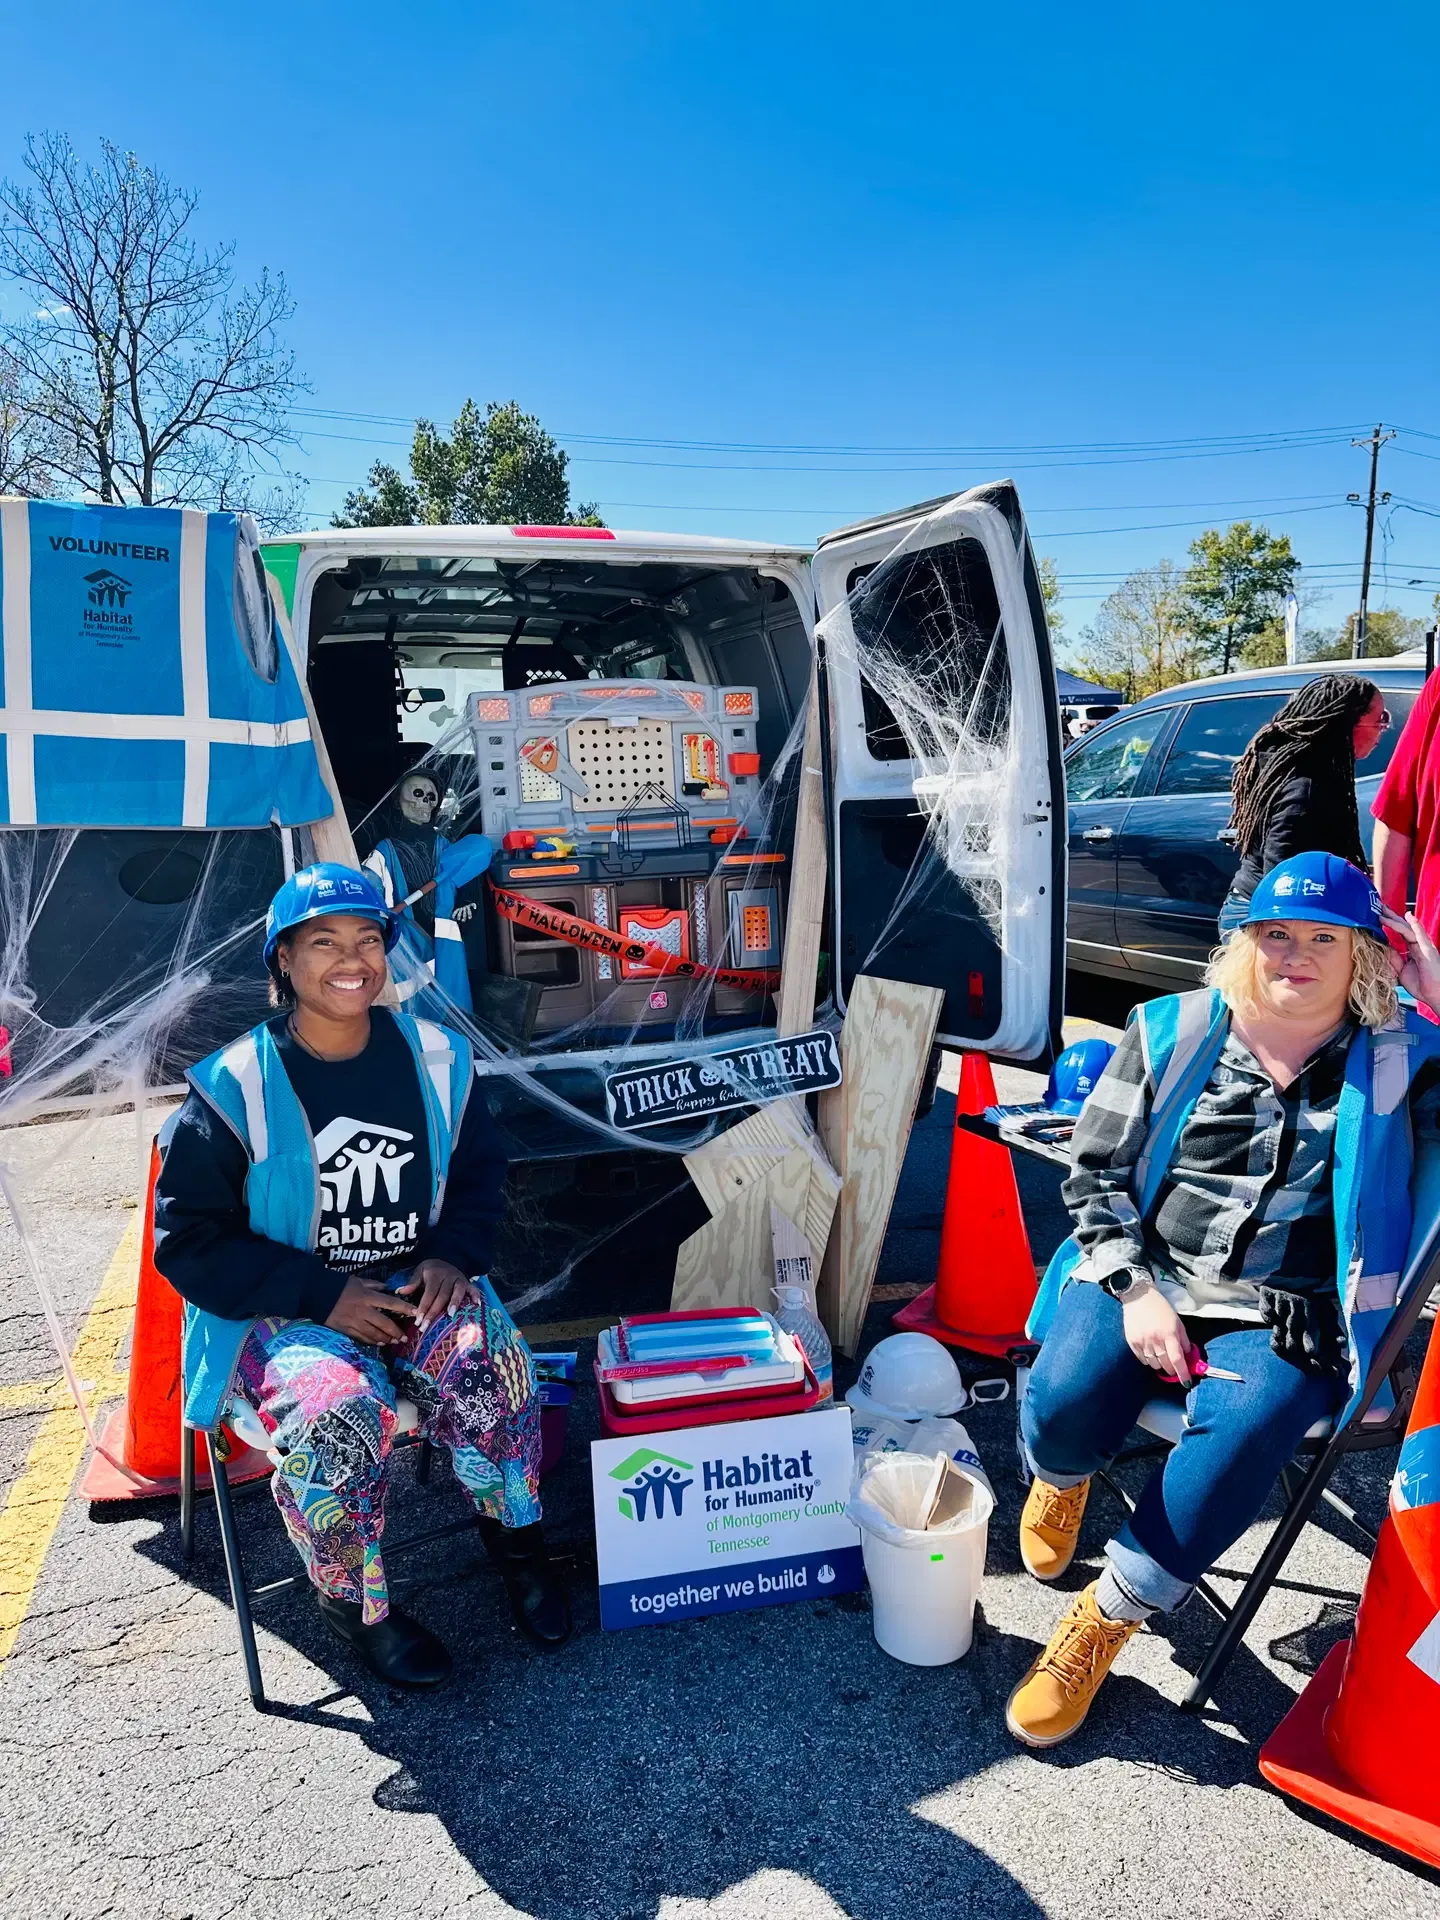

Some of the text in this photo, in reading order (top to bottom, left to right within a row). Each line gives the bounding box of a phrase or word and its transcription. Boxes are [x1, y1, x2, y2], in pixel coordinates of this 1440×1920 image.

[48, 536, 170, 562] VOLUNTEER
[83, 608, 133, 625] Habitat
[528, 906, 623, 954] HALLOWEEN
[615, 1067, 697, 1119] TRICK
[738, 1039, 828, 1080] TREAT
[676, 1096, 716, 1111] happy
[316, 1212, 419, 1247] abitat
[703, 1450, 813, 1491] Habitat
[705, 1495, 729, 1512] for
[706, 1500, 846, 1532] of Montgomery County
[707, 1536, 770, 1554] Tennessee
[630, 1567, 807, 1613] together we build
